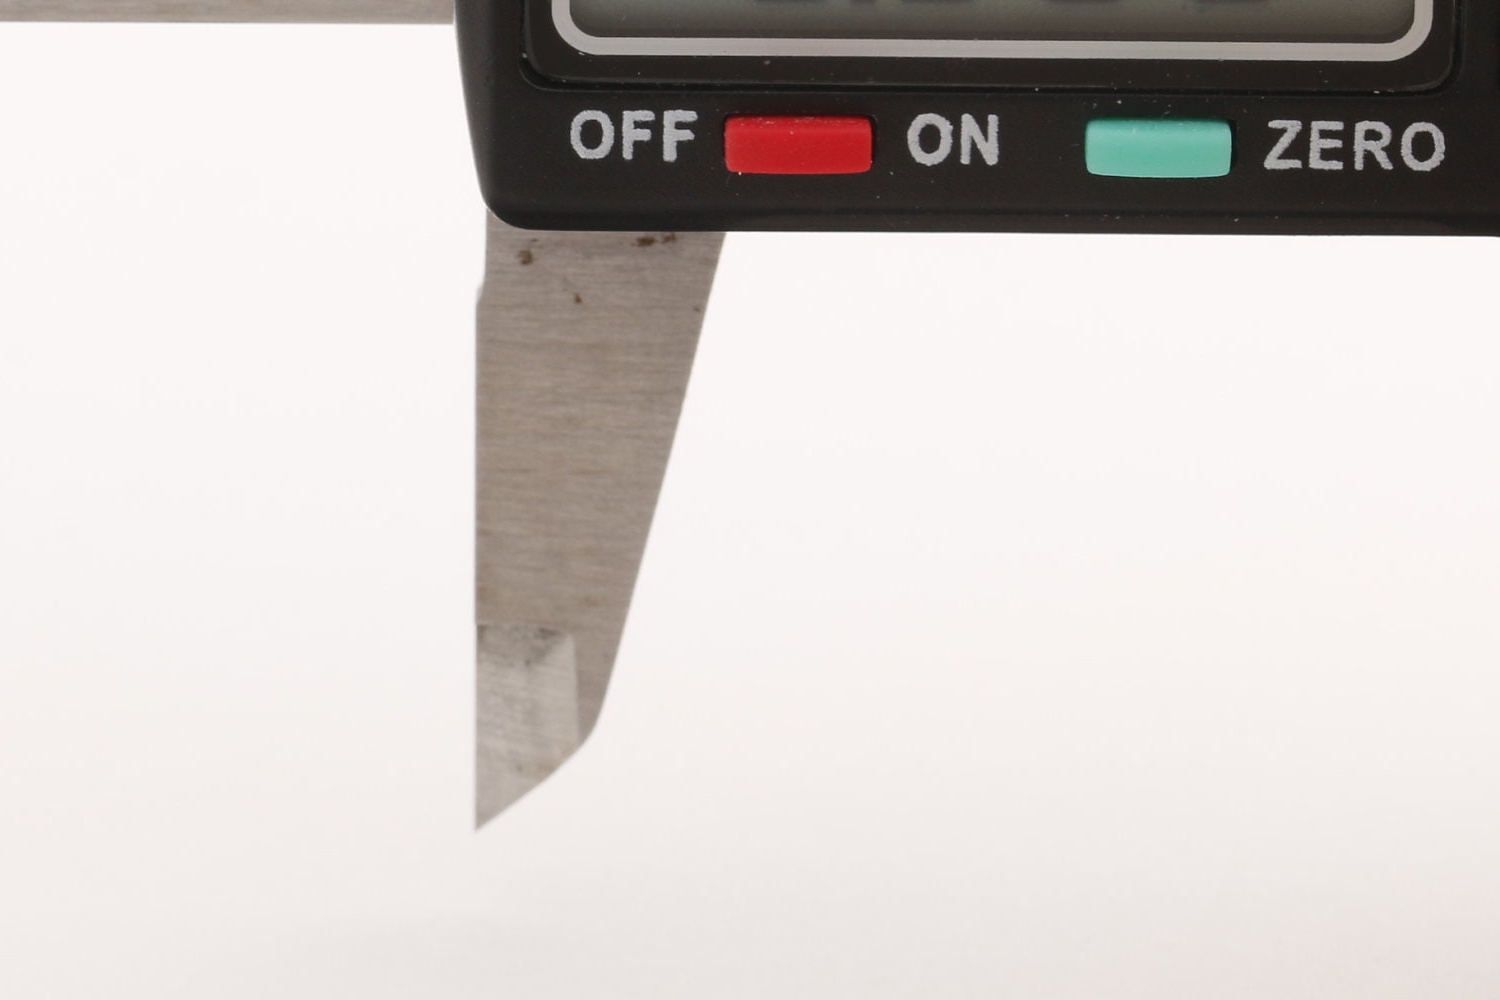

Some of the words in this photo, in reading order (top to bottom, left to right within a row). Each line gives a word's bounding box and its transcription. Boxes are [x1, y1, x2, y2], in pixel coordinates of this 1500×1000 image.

[570, 109, 698, 161] OFF
[907, 112, 999, 167] ON
[1263, 119, 1446, 172] ZERO
